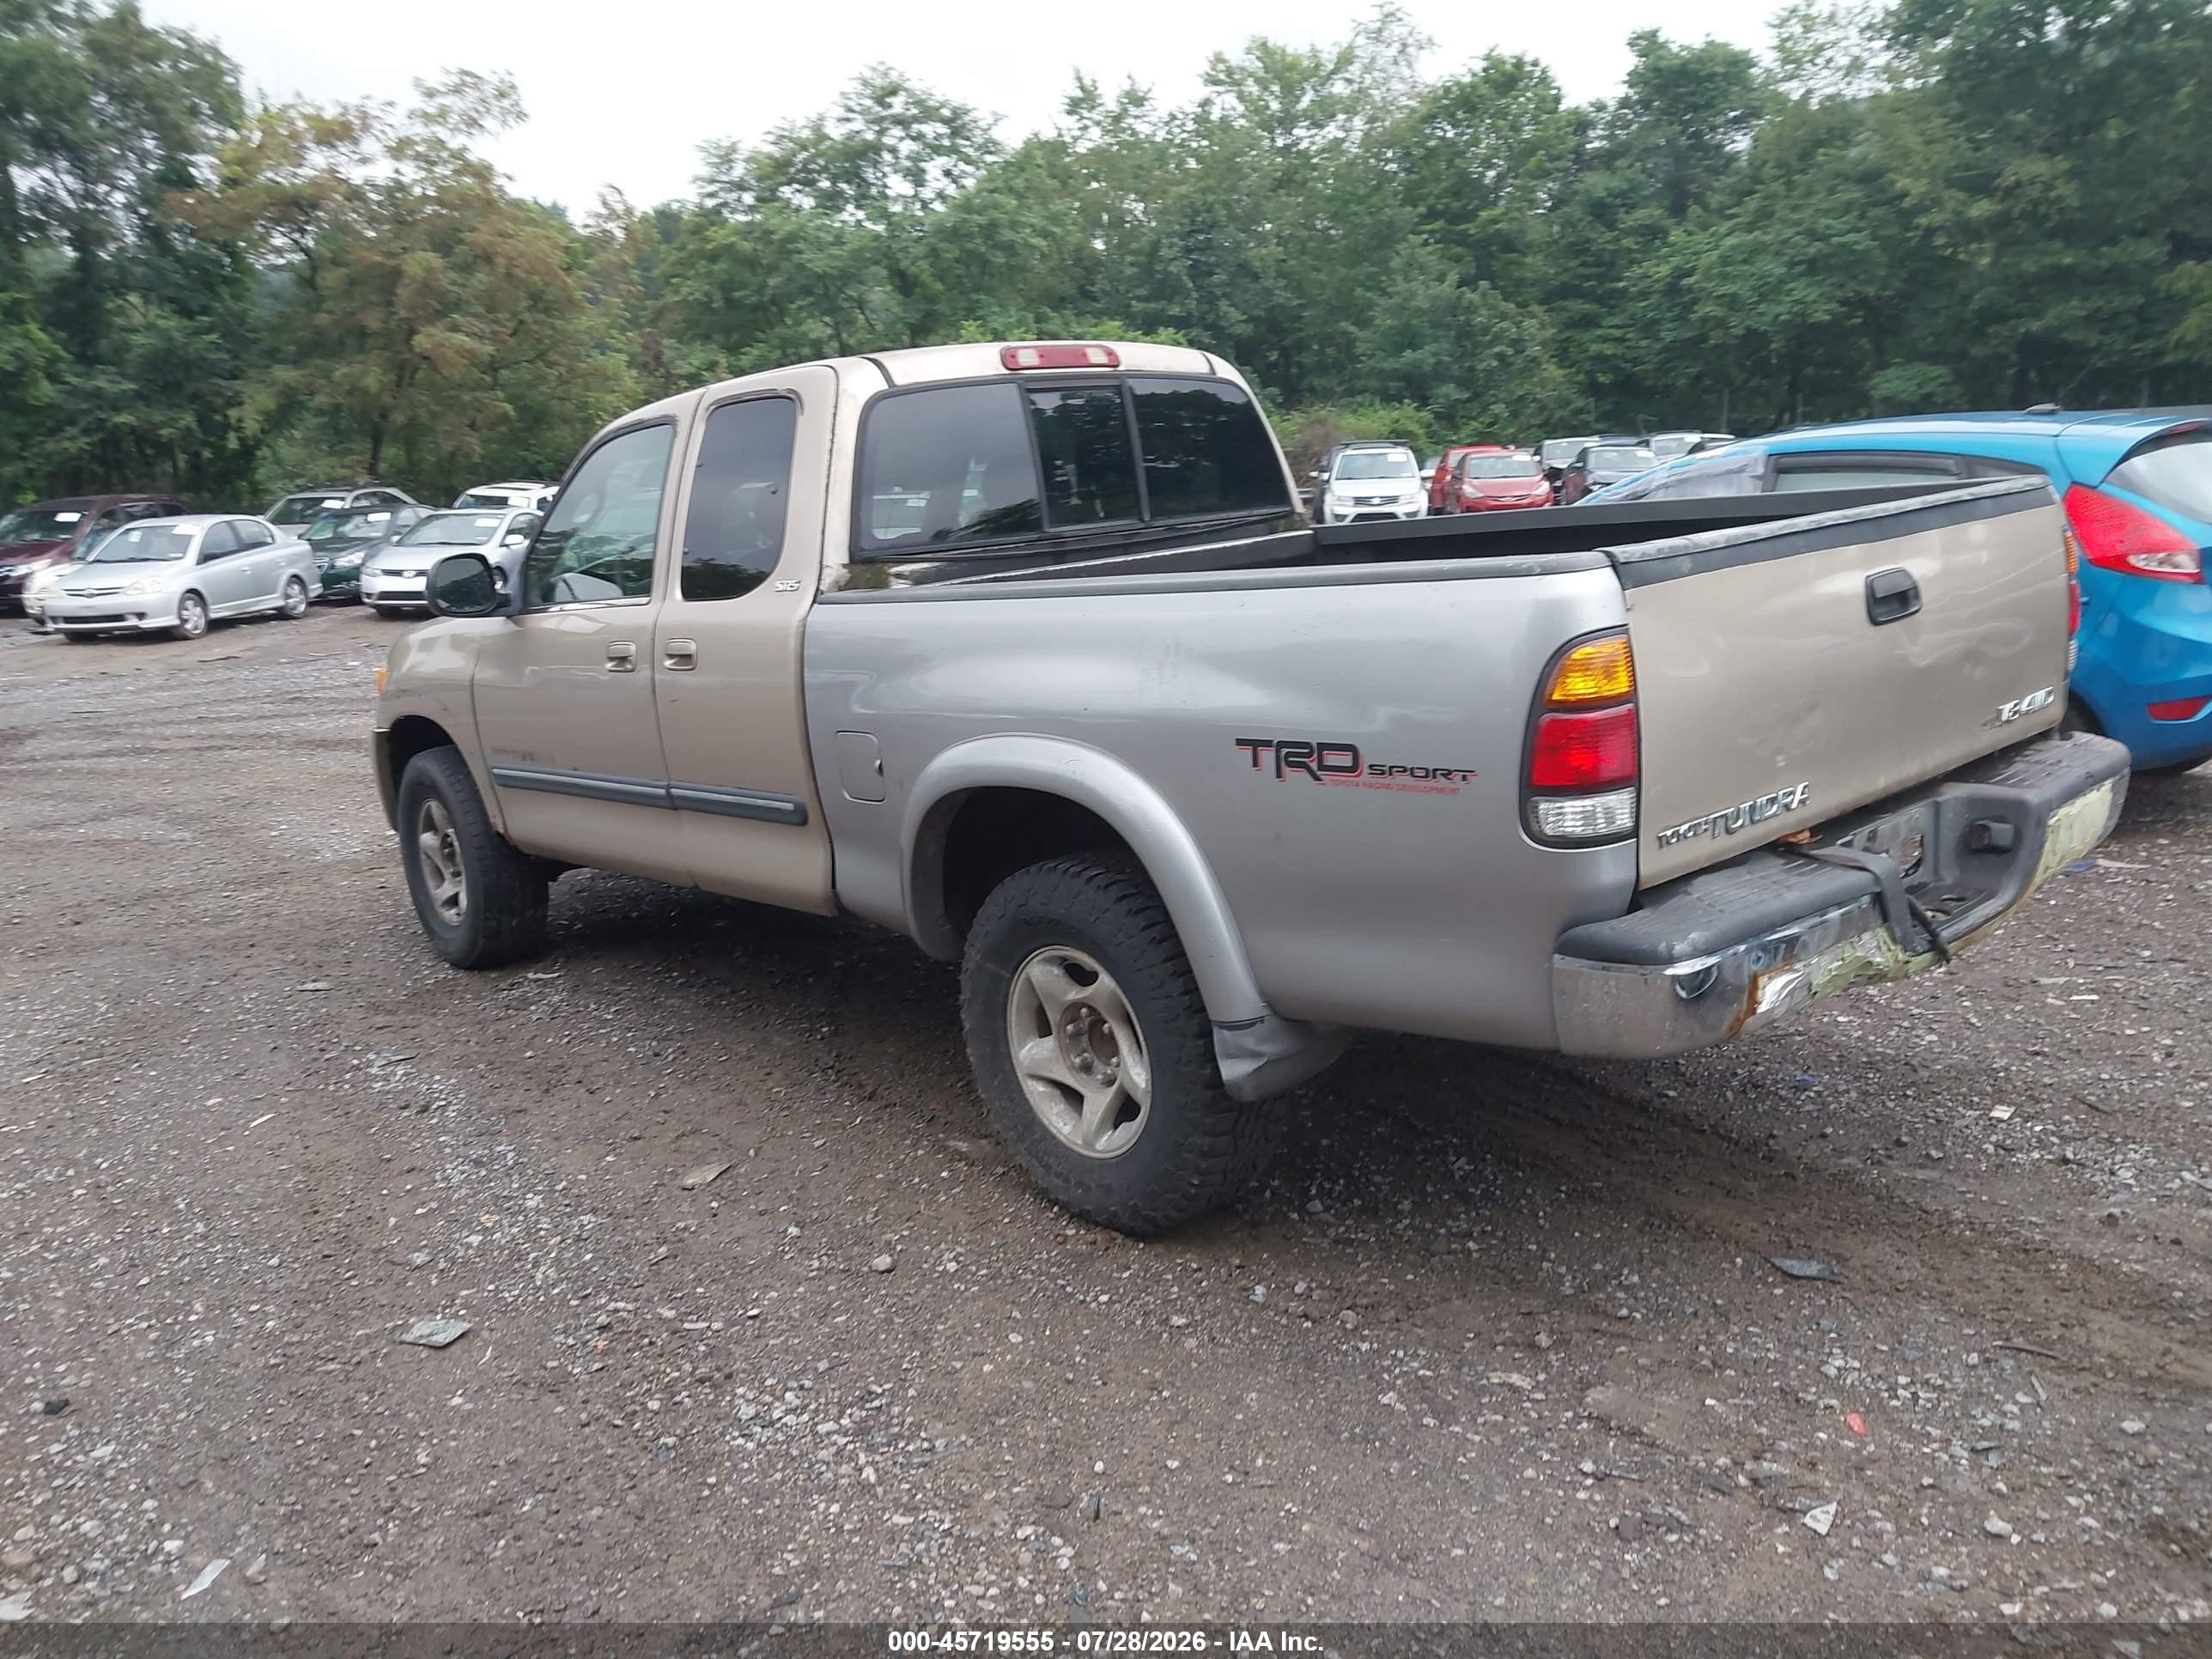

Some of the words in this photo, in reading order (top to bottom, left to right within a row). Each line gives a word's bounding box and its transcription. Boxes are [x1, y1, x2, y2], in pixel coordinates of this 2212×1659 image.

[1235, 738, 1364, 783] TRD
[1367, 763, 1477, 785] SPORT
[1707, 781, 1812, 839] TUNDRA
